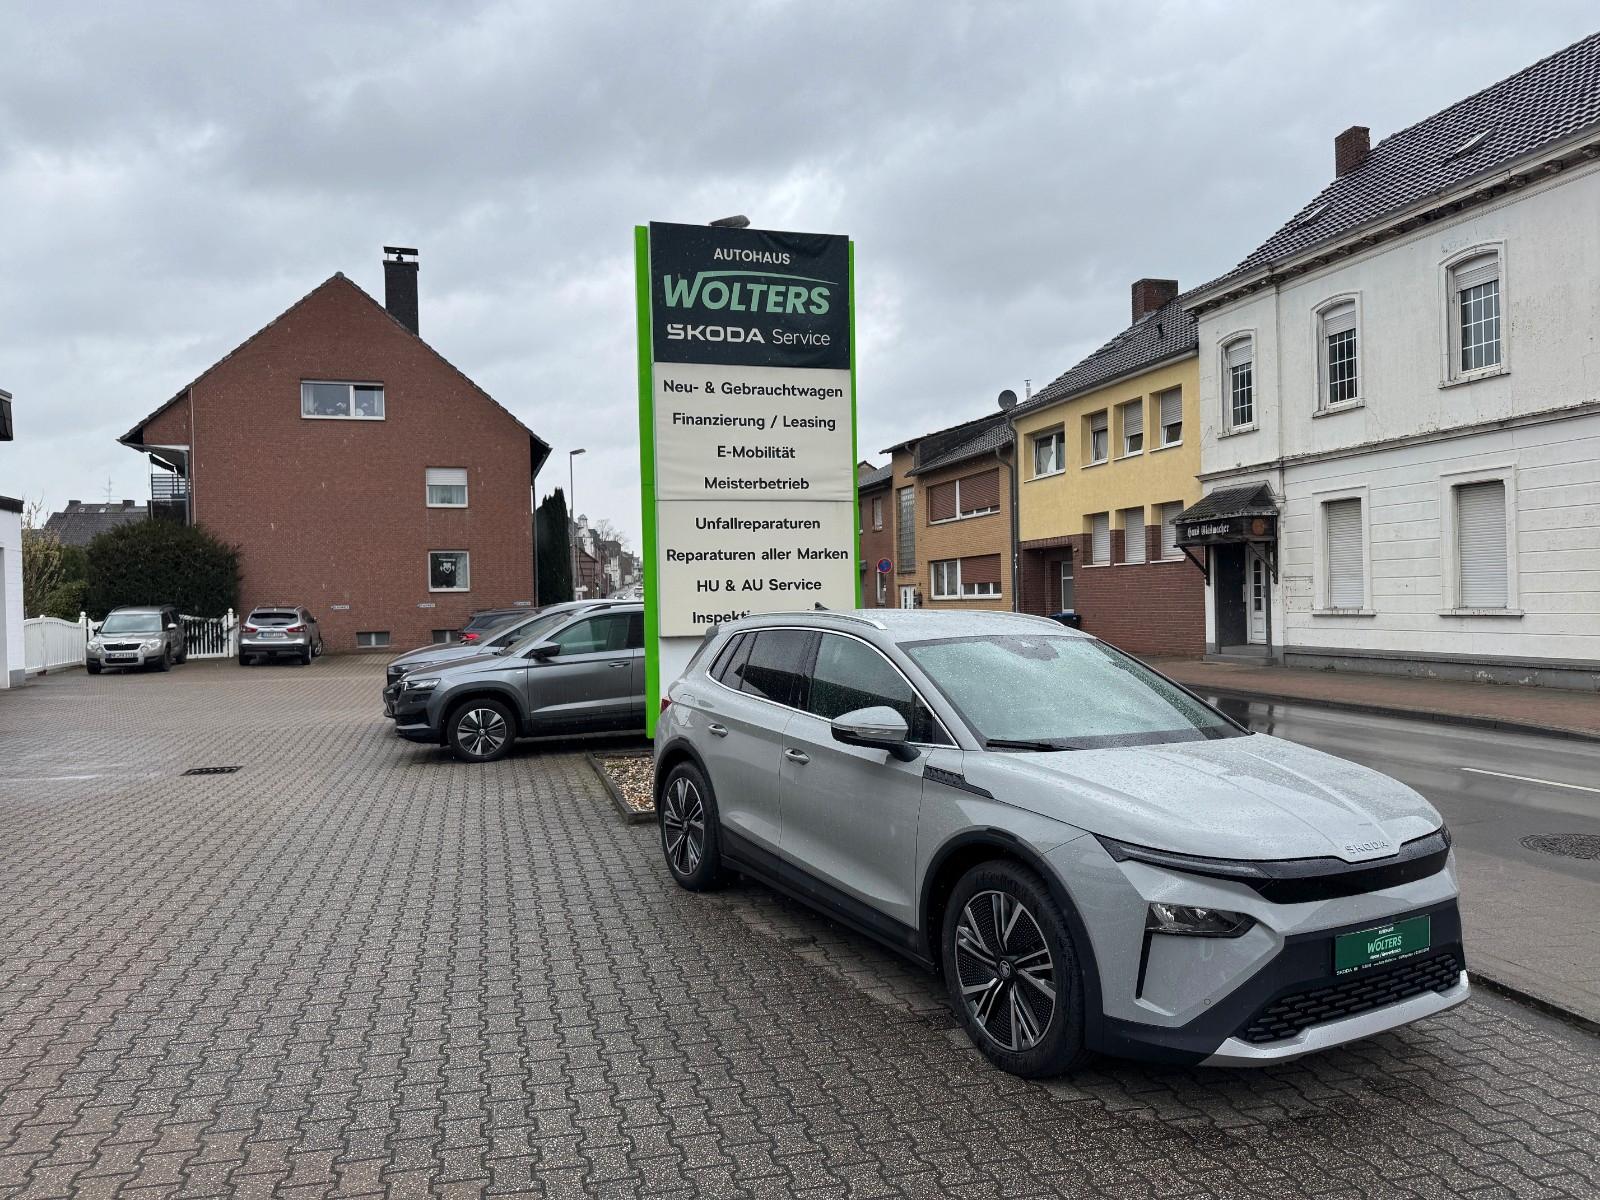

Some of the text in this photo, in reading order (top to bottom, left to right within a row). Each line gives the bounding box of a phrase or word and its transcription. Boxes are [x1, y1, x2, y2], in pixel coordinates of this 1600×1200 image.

[713, 247, 791, 265] AUTOHAUS
[663, 271, 836, 315] WOLTERS
[772, 329, 831, 346] Service
[663, 379, 843, 400] Neu- & Gebrauchtwagen
[672, 412, 836, 431] Finanzierung / Leasing
[717, 445, 796, 459] E-Mobilität
[704, 476, 810, 490] Meisterbetrieb
[695, 517, 821, 532] Unfallreparaturen
[666, 547, 849, 564] Reparaturen aller Marken
[696, 578, 822, 593] HU & AU Service
[692, 610, 750, 626] Inspekt
[1367, 933, 1403, 954] WOLTERS
